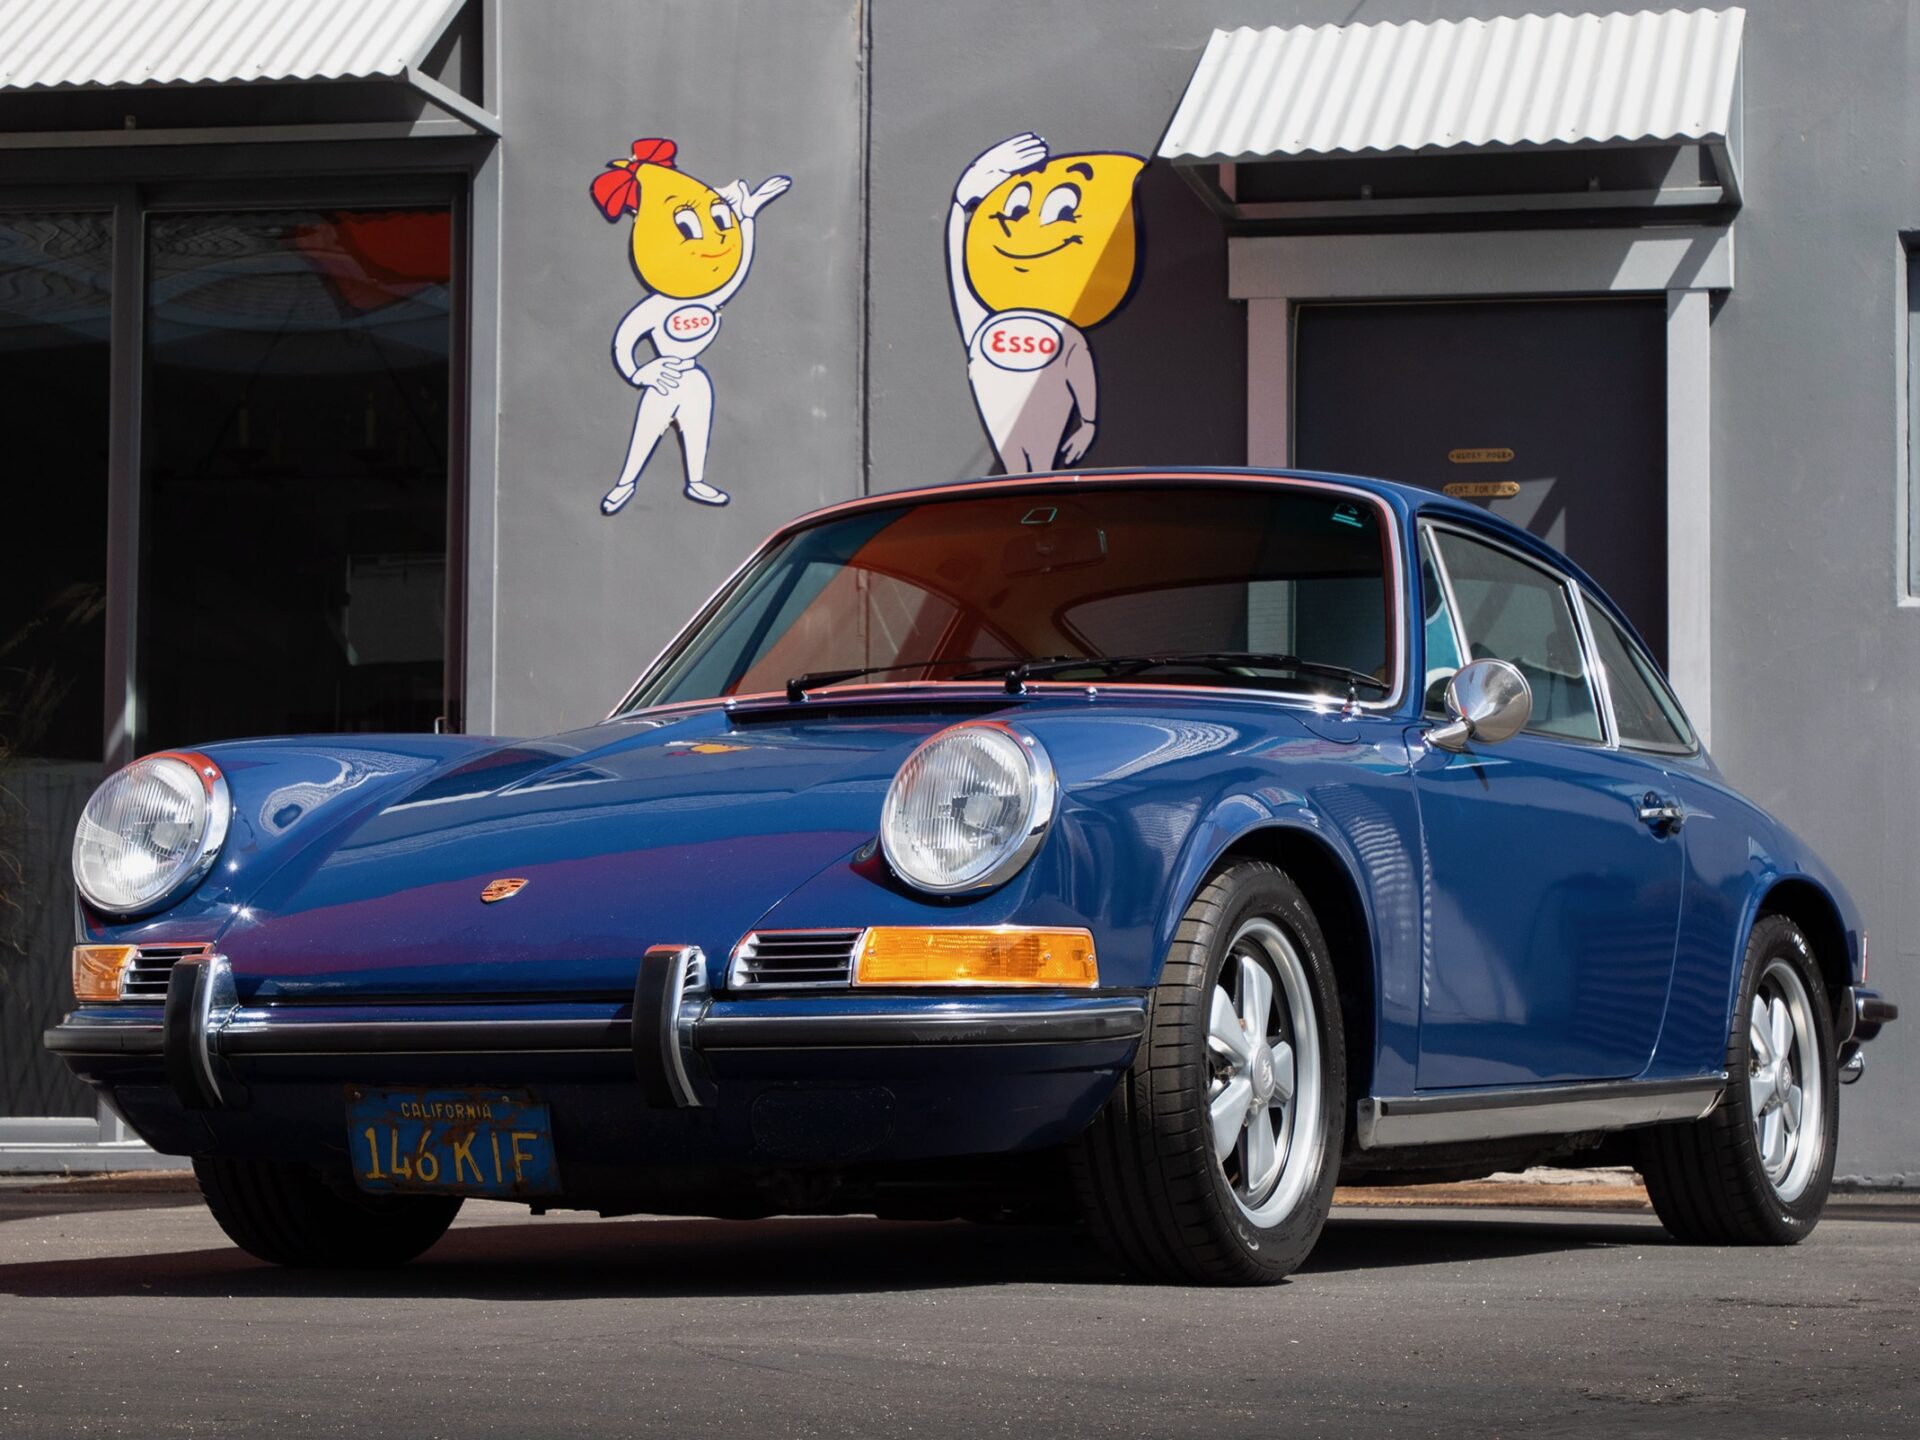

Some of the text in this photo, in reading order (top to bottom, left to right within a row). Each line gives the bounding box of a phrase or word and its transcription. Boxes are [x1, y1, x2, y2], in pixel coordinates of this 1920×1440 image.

[991, 330, 1056, 354] Esso
[400, 1102, 493, 1119] CALIFORNIA
[364, 1126, 538, 1183] 146 KIF
